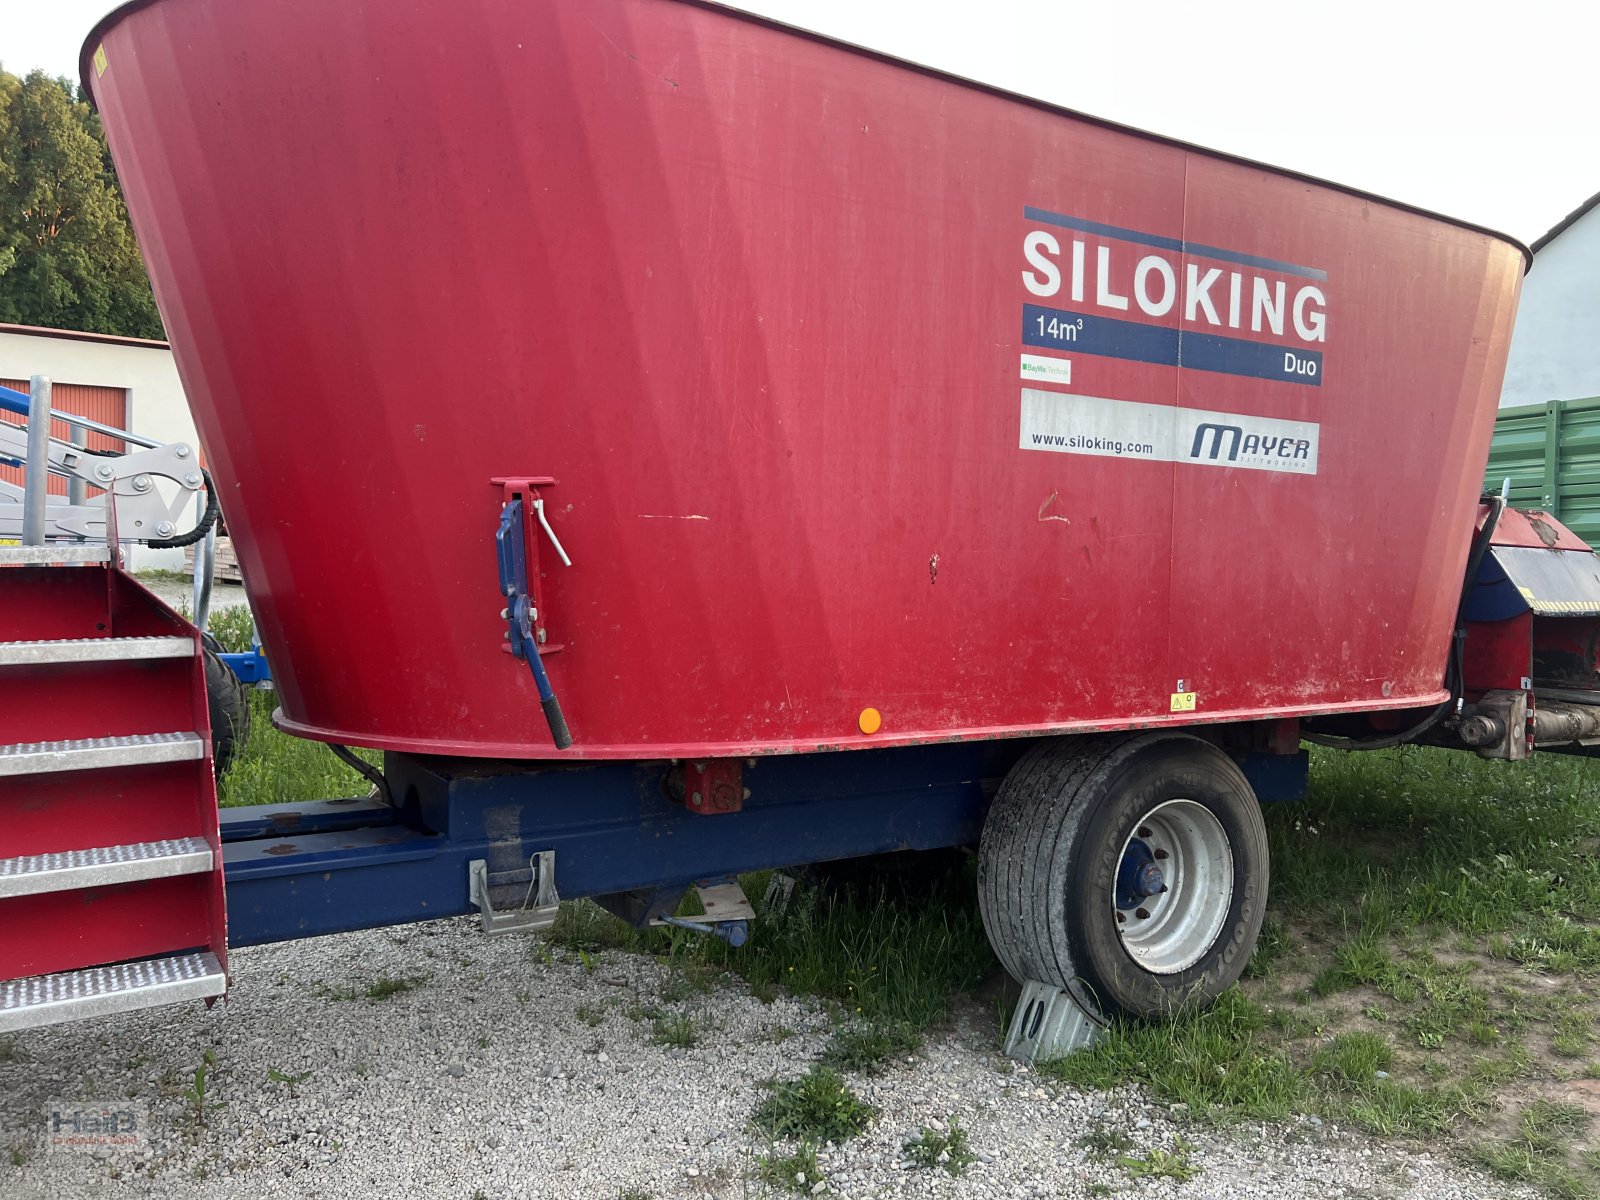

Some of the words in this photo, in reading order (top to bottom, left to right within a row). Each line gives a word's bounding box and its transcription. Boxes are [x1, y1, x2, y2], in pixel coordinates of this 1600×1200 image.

[1021, 230, 1327, 343] SILOKING
[1283, 352, 1317, 377] Duo
[1032, 433, 1153, 454] www.siloking.com
